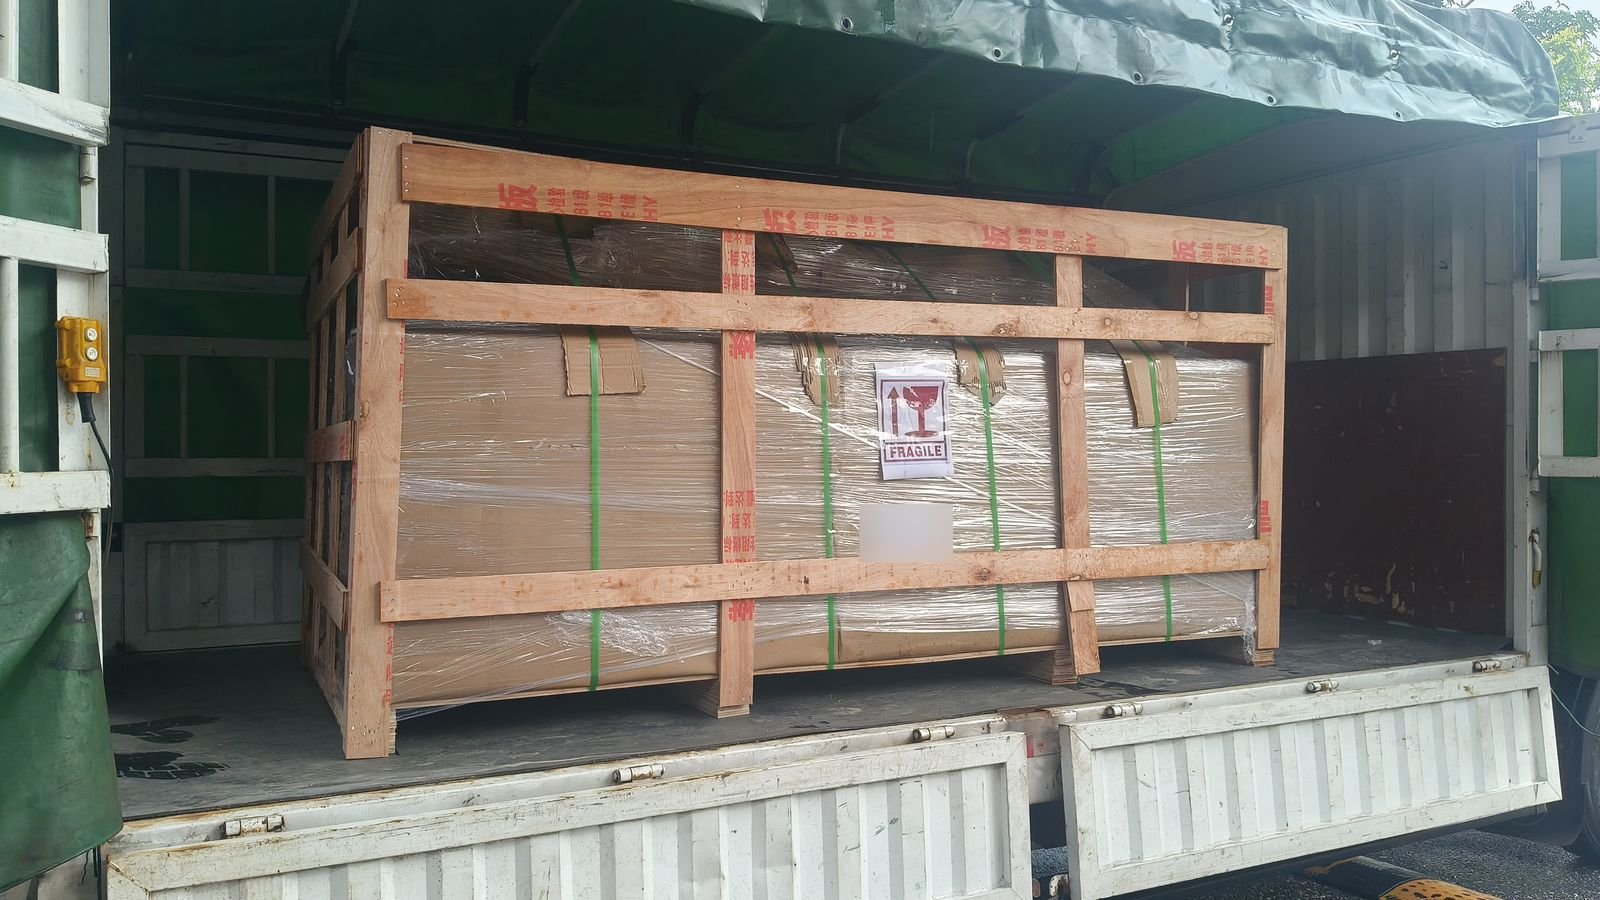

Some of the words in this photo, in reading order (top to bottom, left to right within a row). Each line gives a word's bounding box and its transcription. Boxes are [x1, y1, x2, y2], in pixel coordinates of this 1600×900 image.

[642, 195, 657, 221] HY
[881, 216, 896, 240] HY
[1086, 231, 1097, 253] HY
[1259, 246, 1268, 265] HY
[889, 445, 942, 458] FRAGILE
